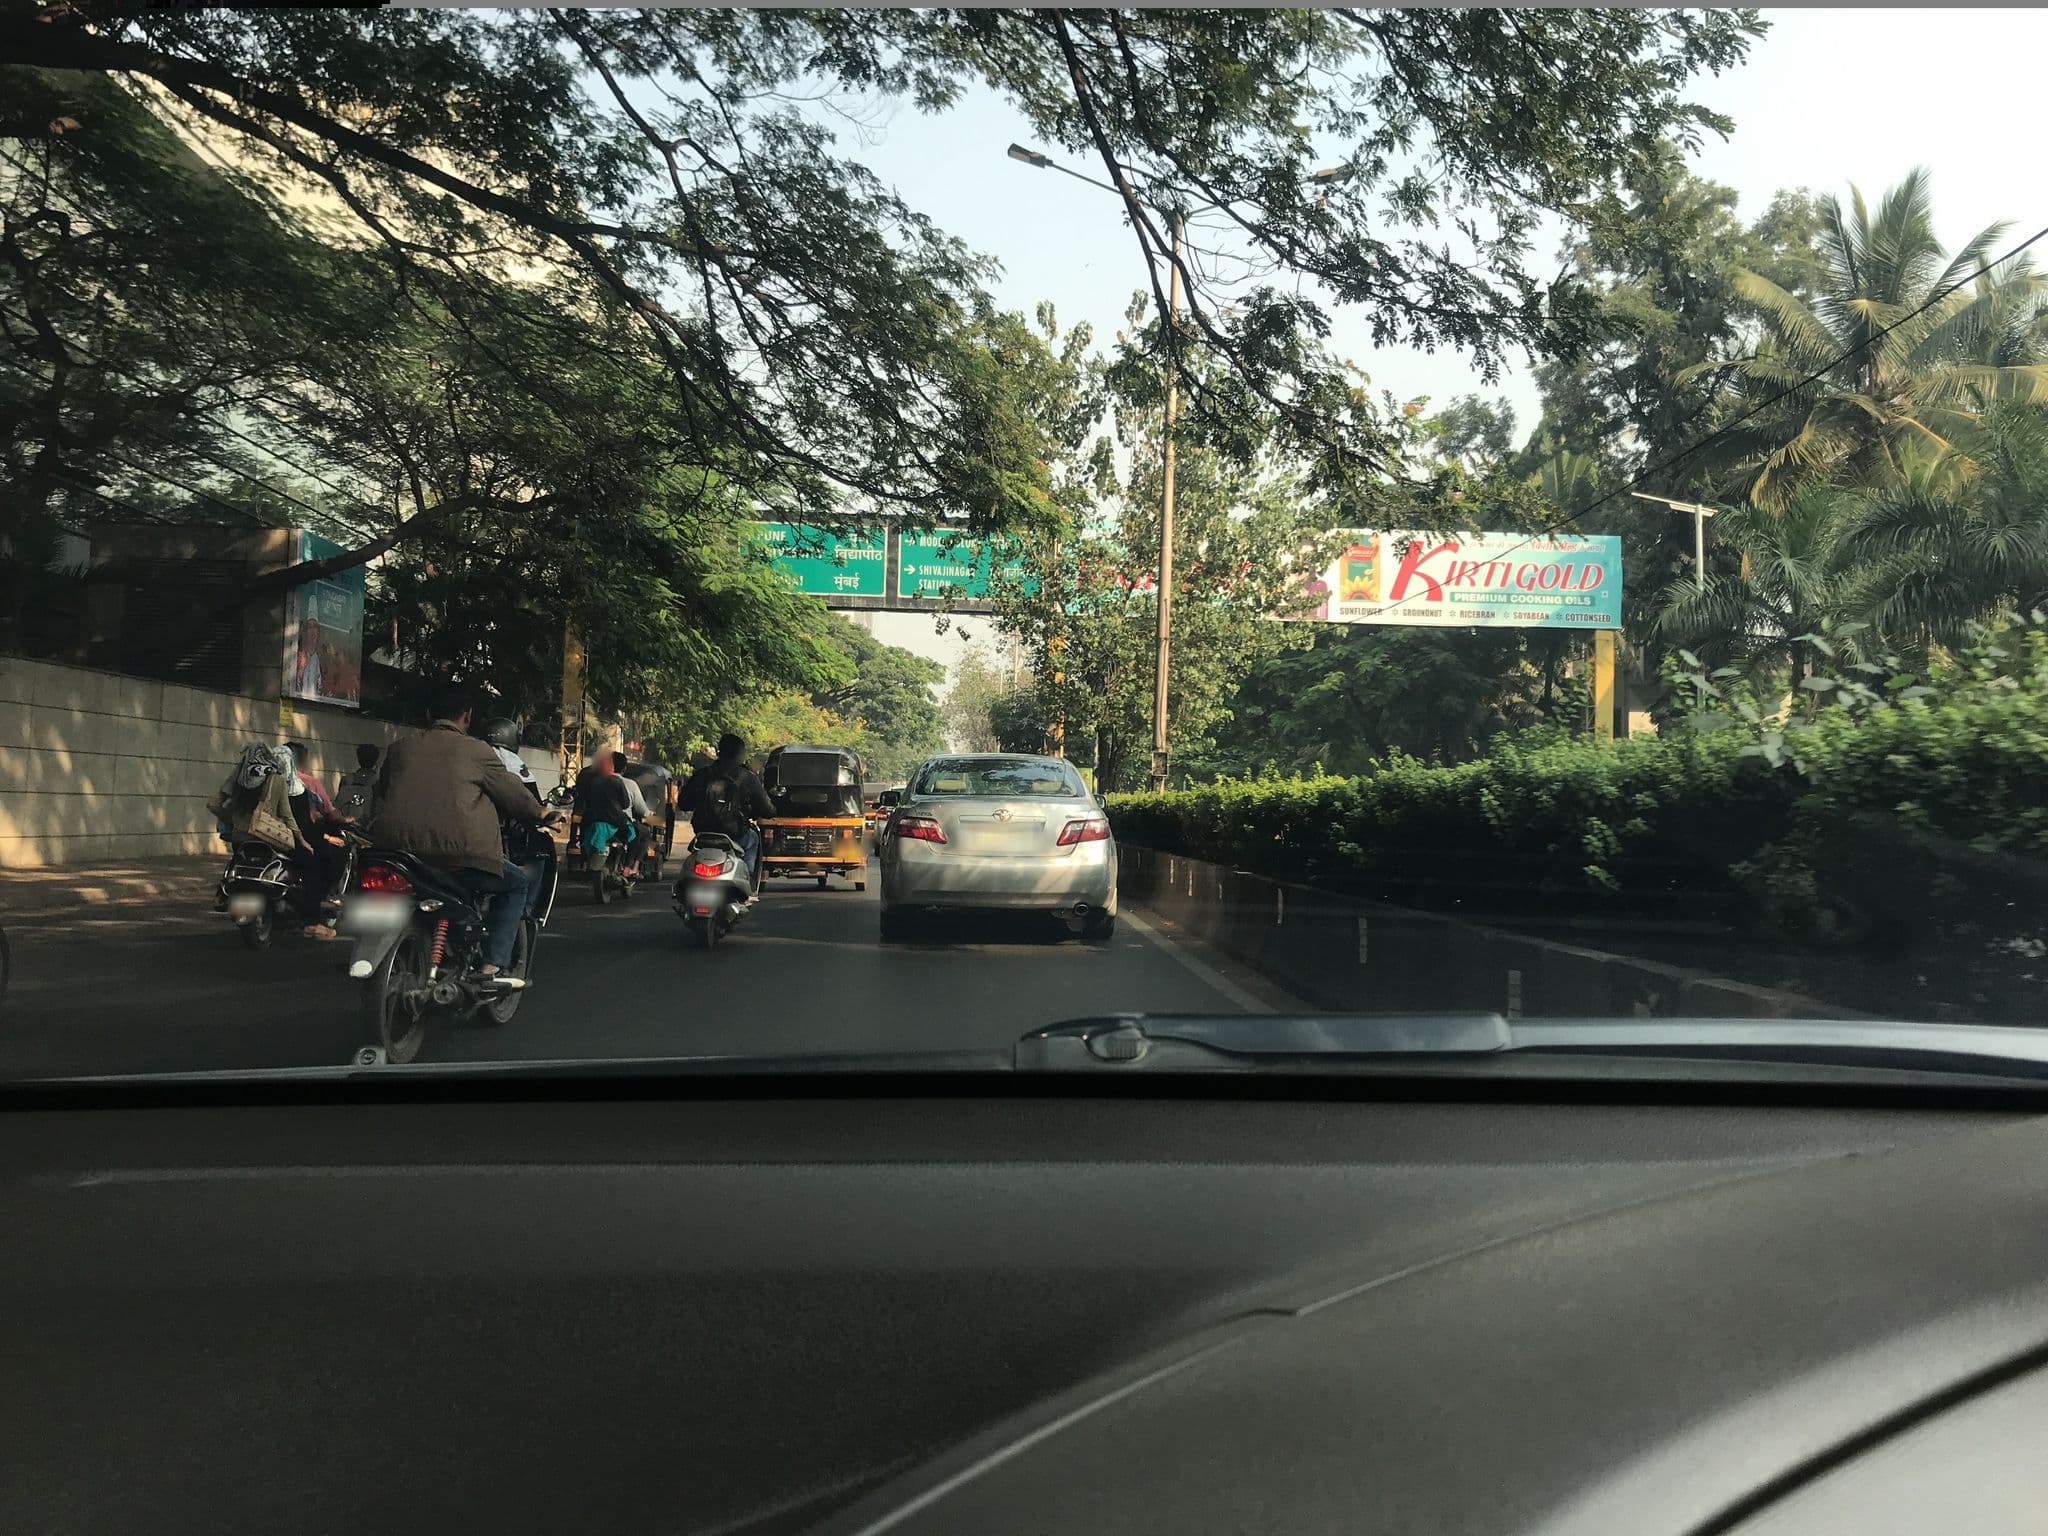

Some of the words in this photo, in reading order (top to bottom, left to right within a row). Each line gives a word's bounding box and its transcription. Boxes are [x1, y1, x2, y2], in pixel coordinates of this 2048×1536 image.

[833, 572, 860, 590] मुंबई
[1454, 592, 1508, 603] PREMIUM
[1510, 595, 1562, 605] COOKING
[1564, 596, 1592, 606] OILS
[1340, 607, 1383, 616] SUNFLOWER
[1402, 608, 1442, 617] GROUNDNUT
[1459, 610, 1496, 619] RICEBRAN
[1513, 611, 1549, 621] SOYABEAN
[1565, 613, 1611, 623] COTTONSEED
